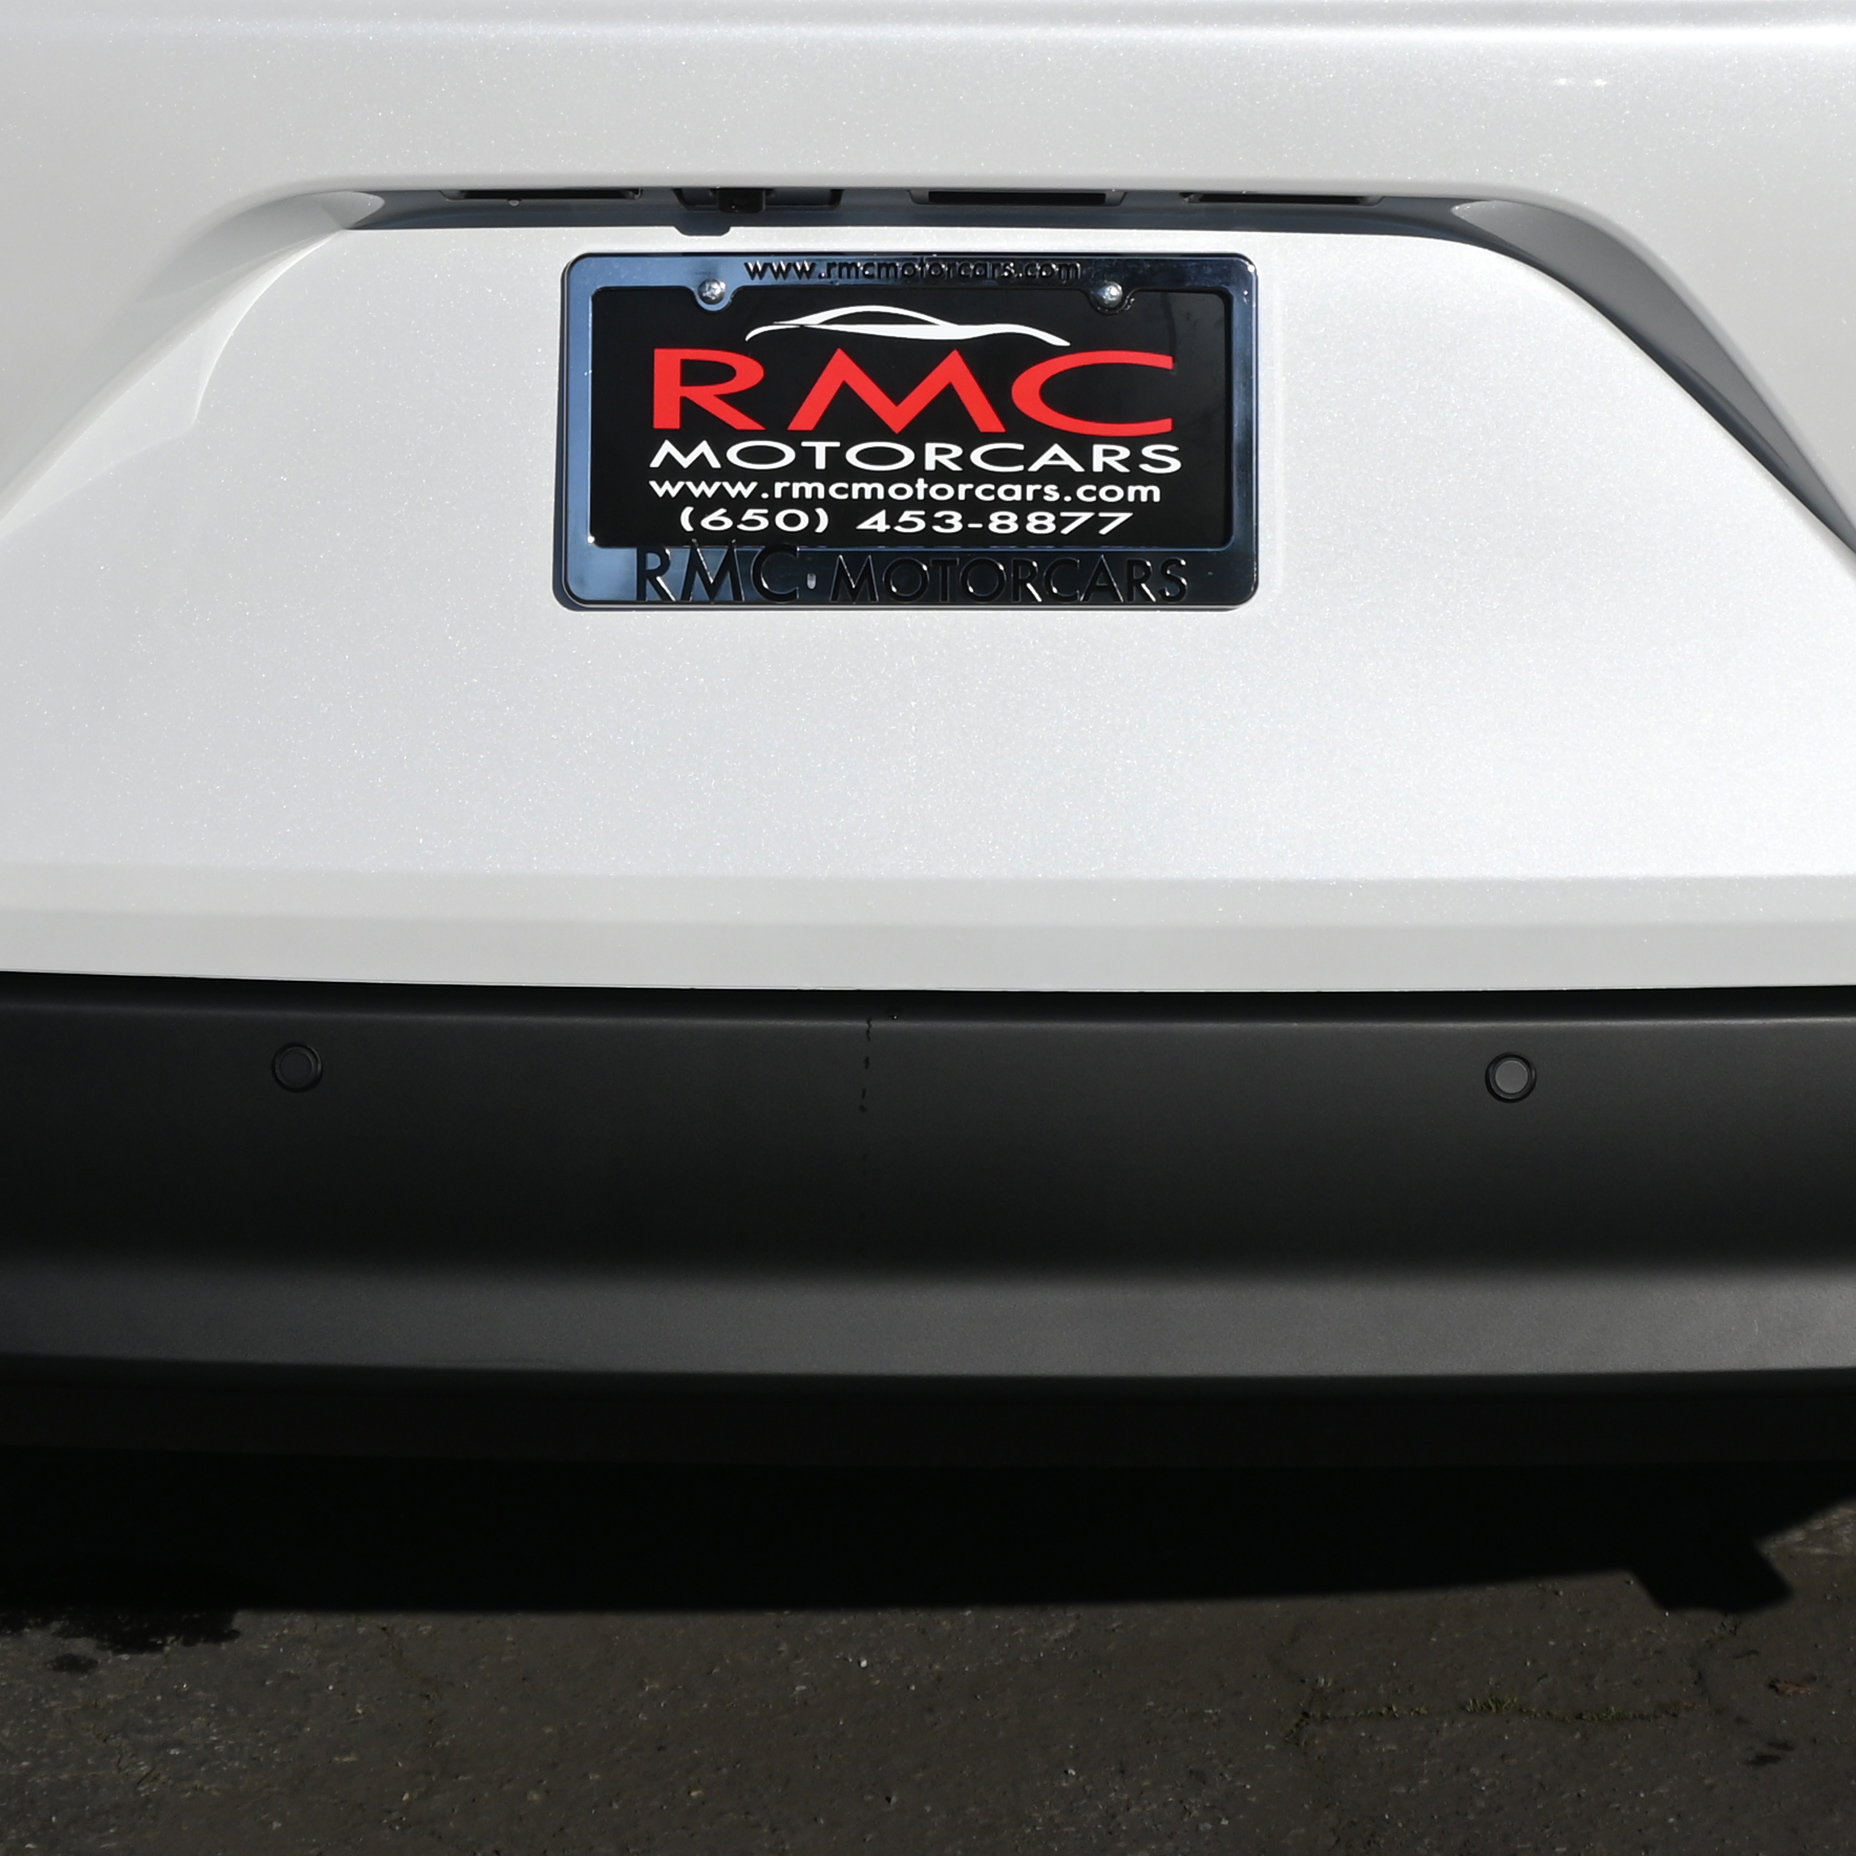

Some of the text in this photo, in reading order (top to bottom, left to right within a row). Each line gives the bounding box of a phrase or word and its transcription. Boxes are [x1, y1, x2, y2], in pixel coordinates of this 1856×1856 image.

[744, 259, 1082, 282] www.rmcmotorcars.com
[652, 347, 1175, 437] RMC
[648, 439, 1184, 475] MOTORCARS
[648, 478, 1163, 504] www.rmcmotorcars.com
[678, 507, 1135, 535] (650) 453-8877
[635, 541, 1190, 604] RMC MOTORCARS
